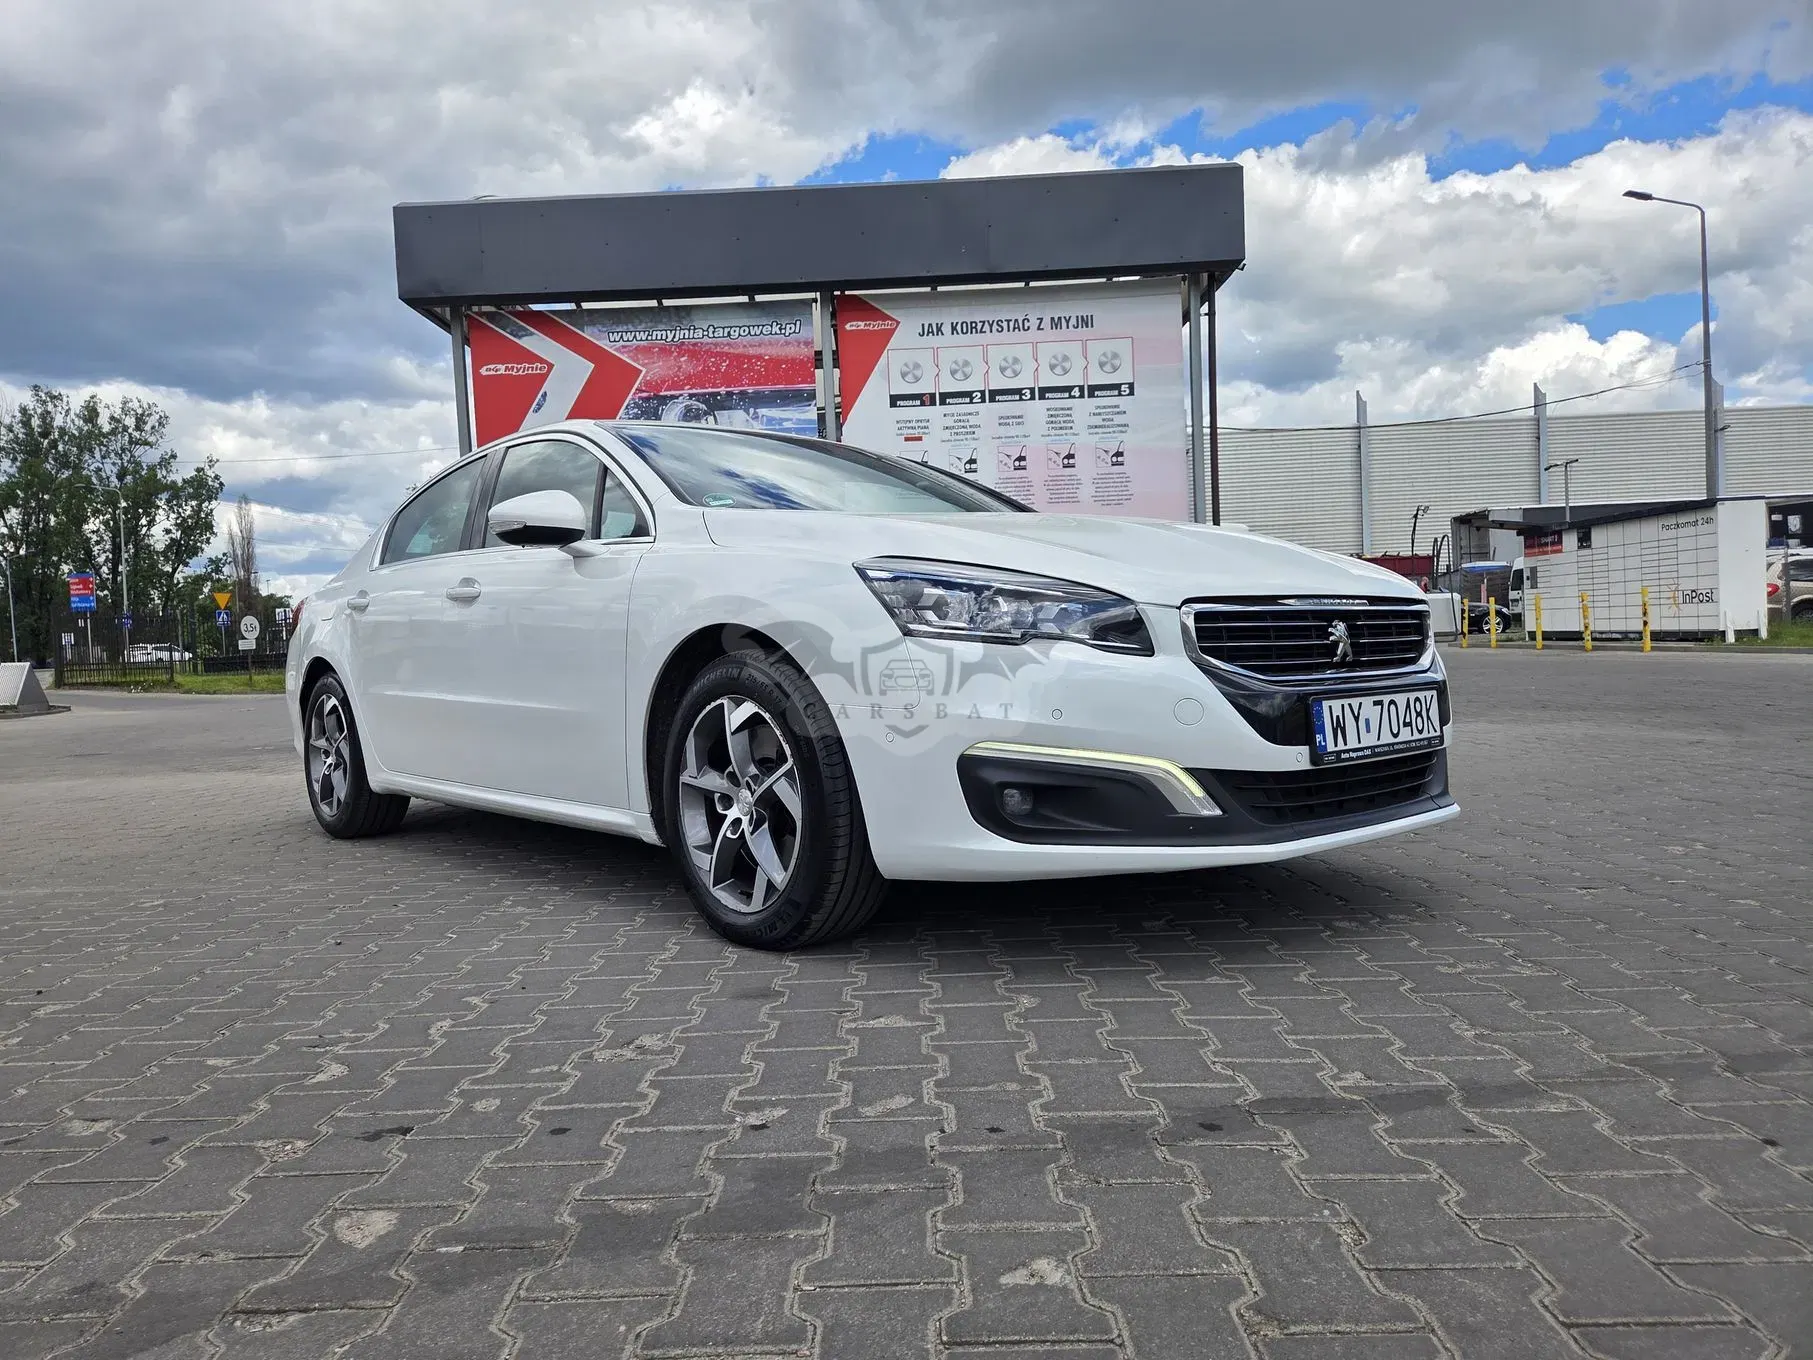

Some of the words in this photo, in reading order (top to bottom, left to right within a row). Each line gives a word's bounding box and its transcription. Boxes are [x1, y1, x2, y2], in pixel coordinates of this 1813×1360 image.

[608, 319, 802, 344] www.myjnia-targowek.pl
[863, 321, 896, 329] Myjnie
[918, 322, 945, 337] JAK
[950, 313, 1031, 336] KORZYSTAĆ
[1036, 318, 1044, 331] Z
[1050, 314, 1095, 331] MYJNI
[504, 364, 547, 374] Myjnie
[1021, 388, 1031, 400] 3
[1071, 386, 1080, 397] 4
[1120, 383, 1130, 396] 5
[923, 393, 930, 406] 1
[972, 391, 981, 403] 2
[1661, 519, 1699, 531] Paczkomat
[1700, 516, 1714, 525] 24h
[1682, 588, 1714, 604] InPost
[692, 667, 742, 696] MICHELIN
[1328, 701, 1363, 748] WY
[1372, 694, 1438, 742] 7048K
[1316, 733, 1325, 746] PL
